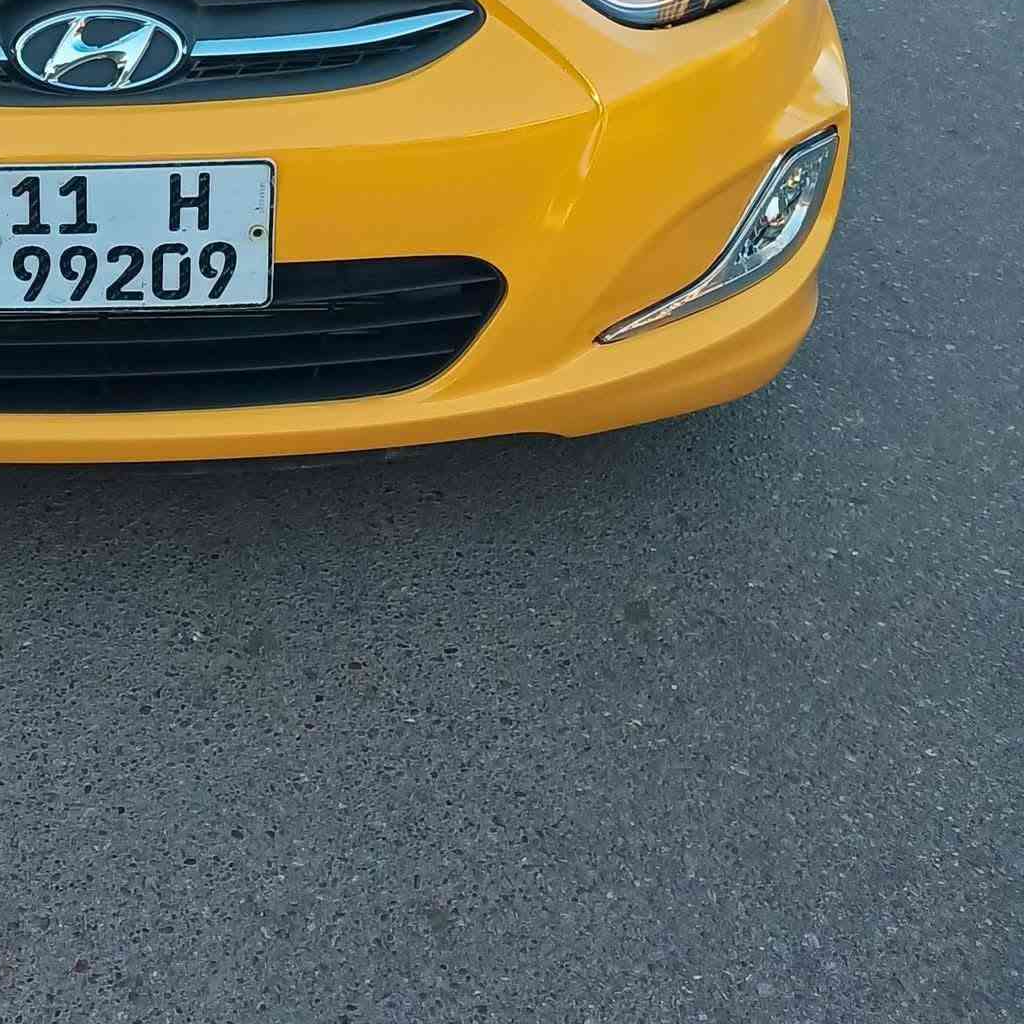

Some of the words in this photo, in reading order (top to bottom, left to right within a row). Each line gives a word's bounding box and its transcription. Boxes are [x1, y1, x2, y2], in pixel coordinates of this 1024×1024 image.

[12, 175, 98, 235] 11
[169, 173, 211, 232] H
[12, 241, 238, 302] 99209
